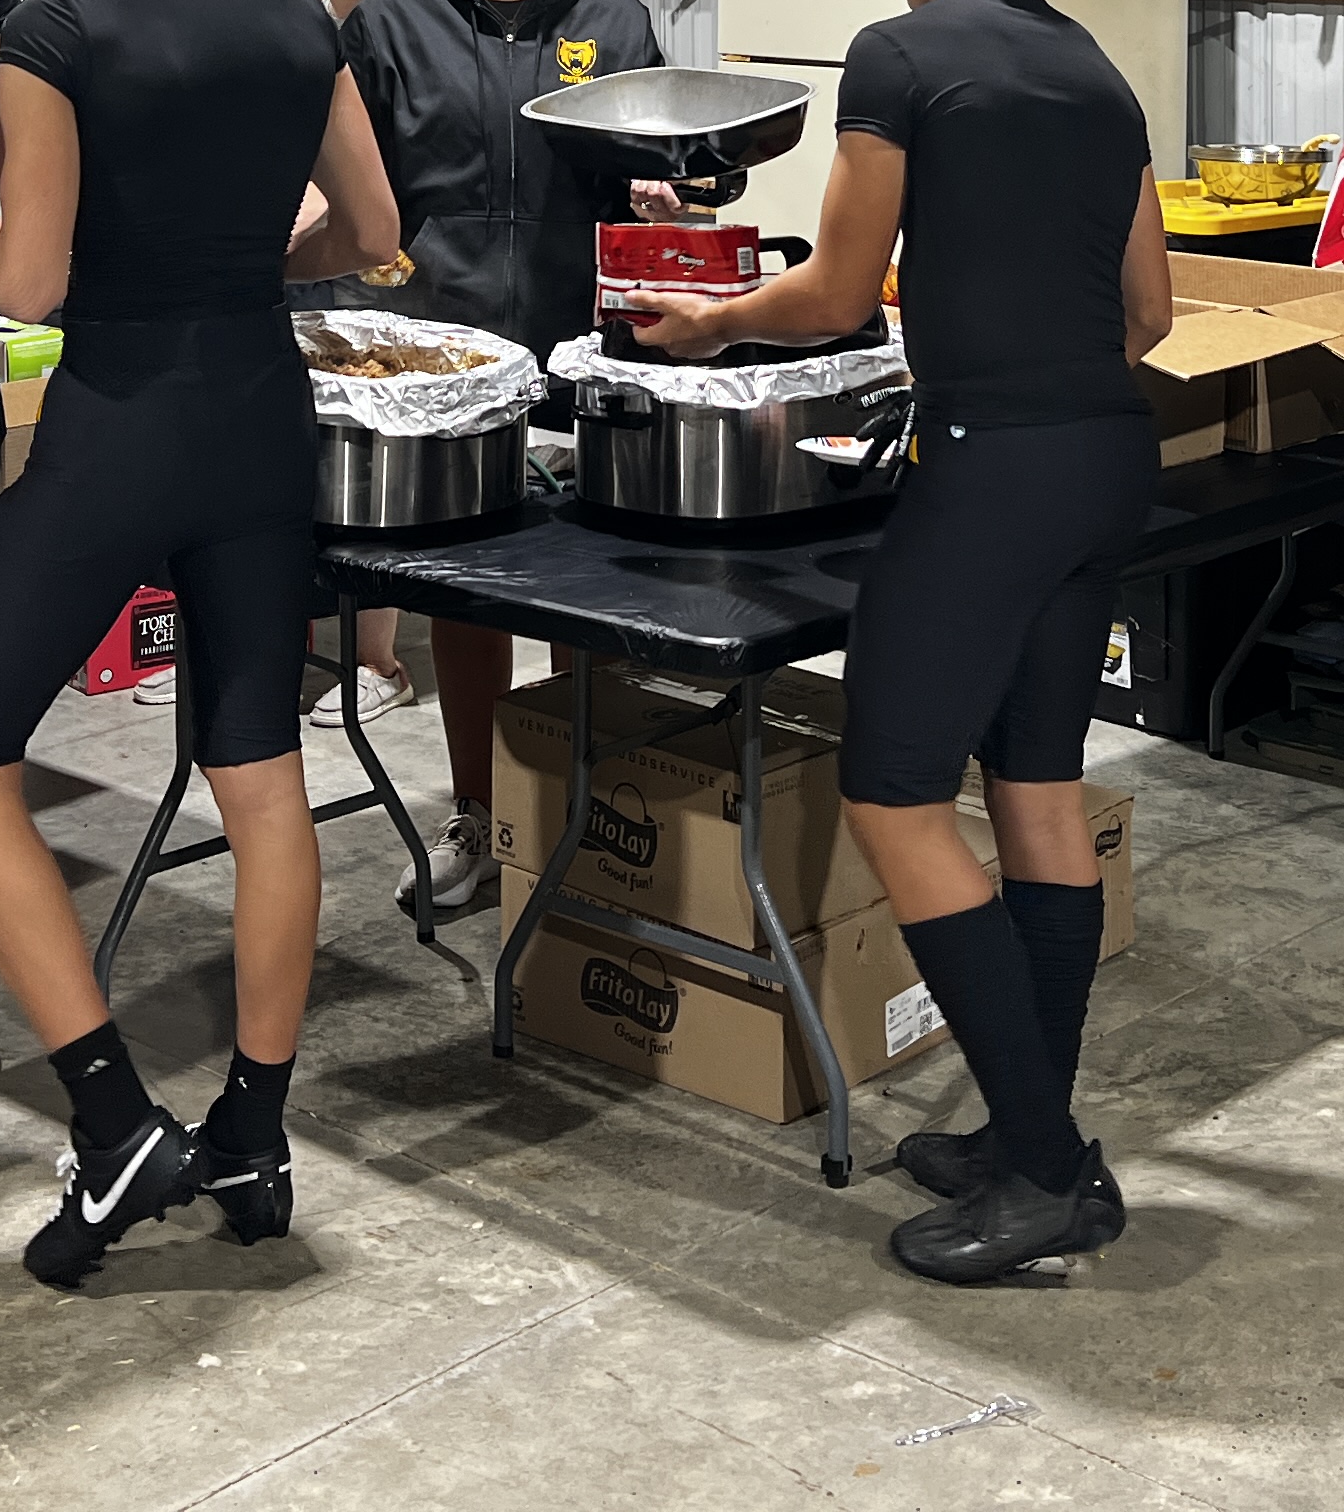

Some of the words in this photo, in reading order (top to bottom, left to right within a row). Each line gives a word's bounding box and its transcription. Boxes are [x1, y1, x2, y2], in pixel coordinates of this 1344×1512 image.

[139, 613, 176, 635] TORT
[153, 628, 175, 644] CH
[518, 717, 572, 743] VENDIN
[618, 751, 716, 788] OODSERVICE
[598, 858, 629, 885] Good
[629, 873, 654, 892] fun!
[614, 1022, 646, 1052] Good
[646, 1035, 674, 1056] fun!
